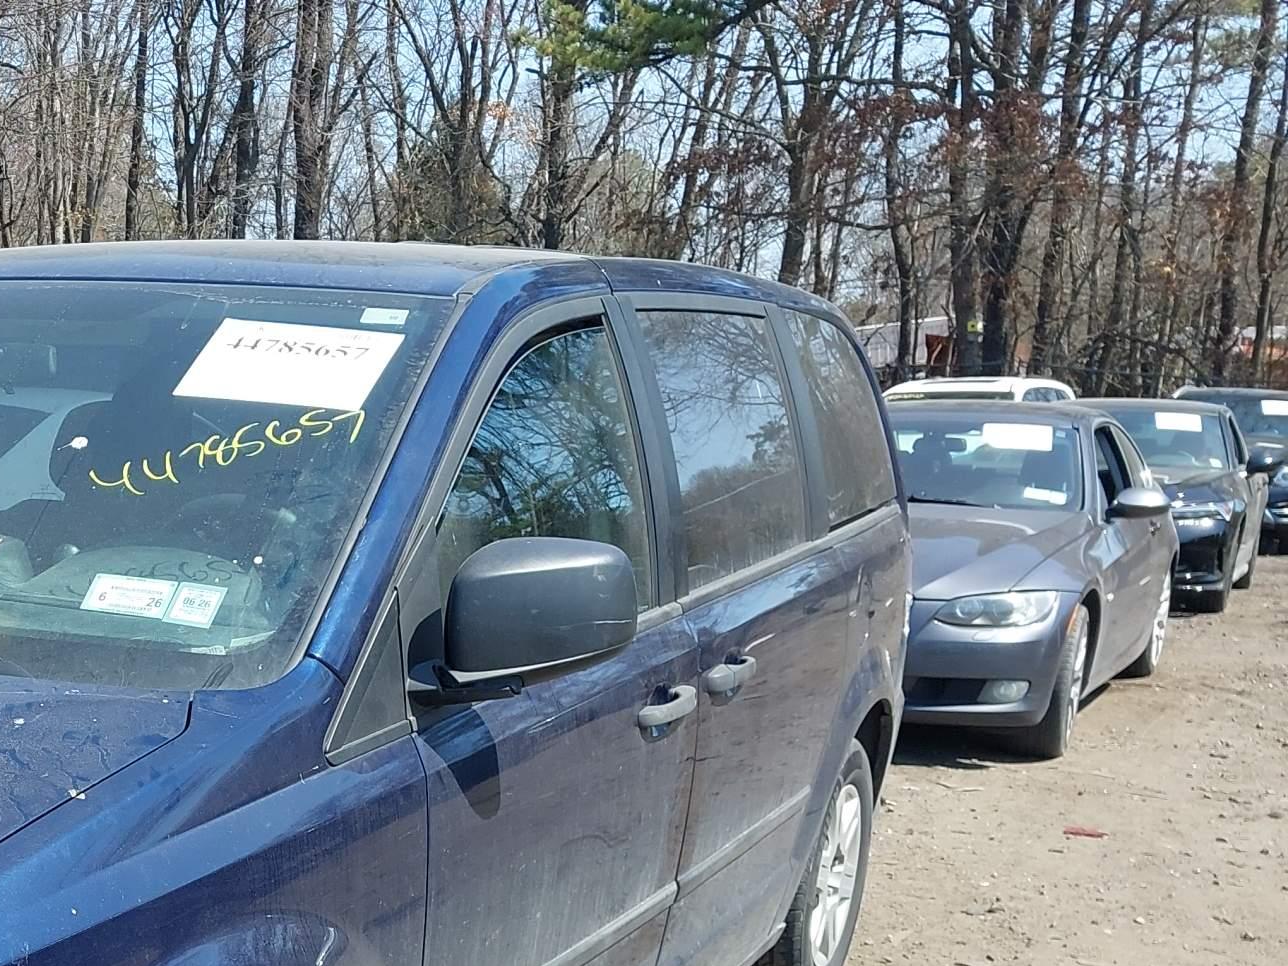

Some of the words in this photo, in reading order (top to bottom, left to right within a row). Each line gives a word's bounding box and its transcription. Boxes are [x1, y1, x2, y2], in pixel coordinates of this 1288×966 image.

[226, 336, 370, 360] 44785657
[88, 409, 365, 495] 44785657
[145, 597, 164, 608] 26
